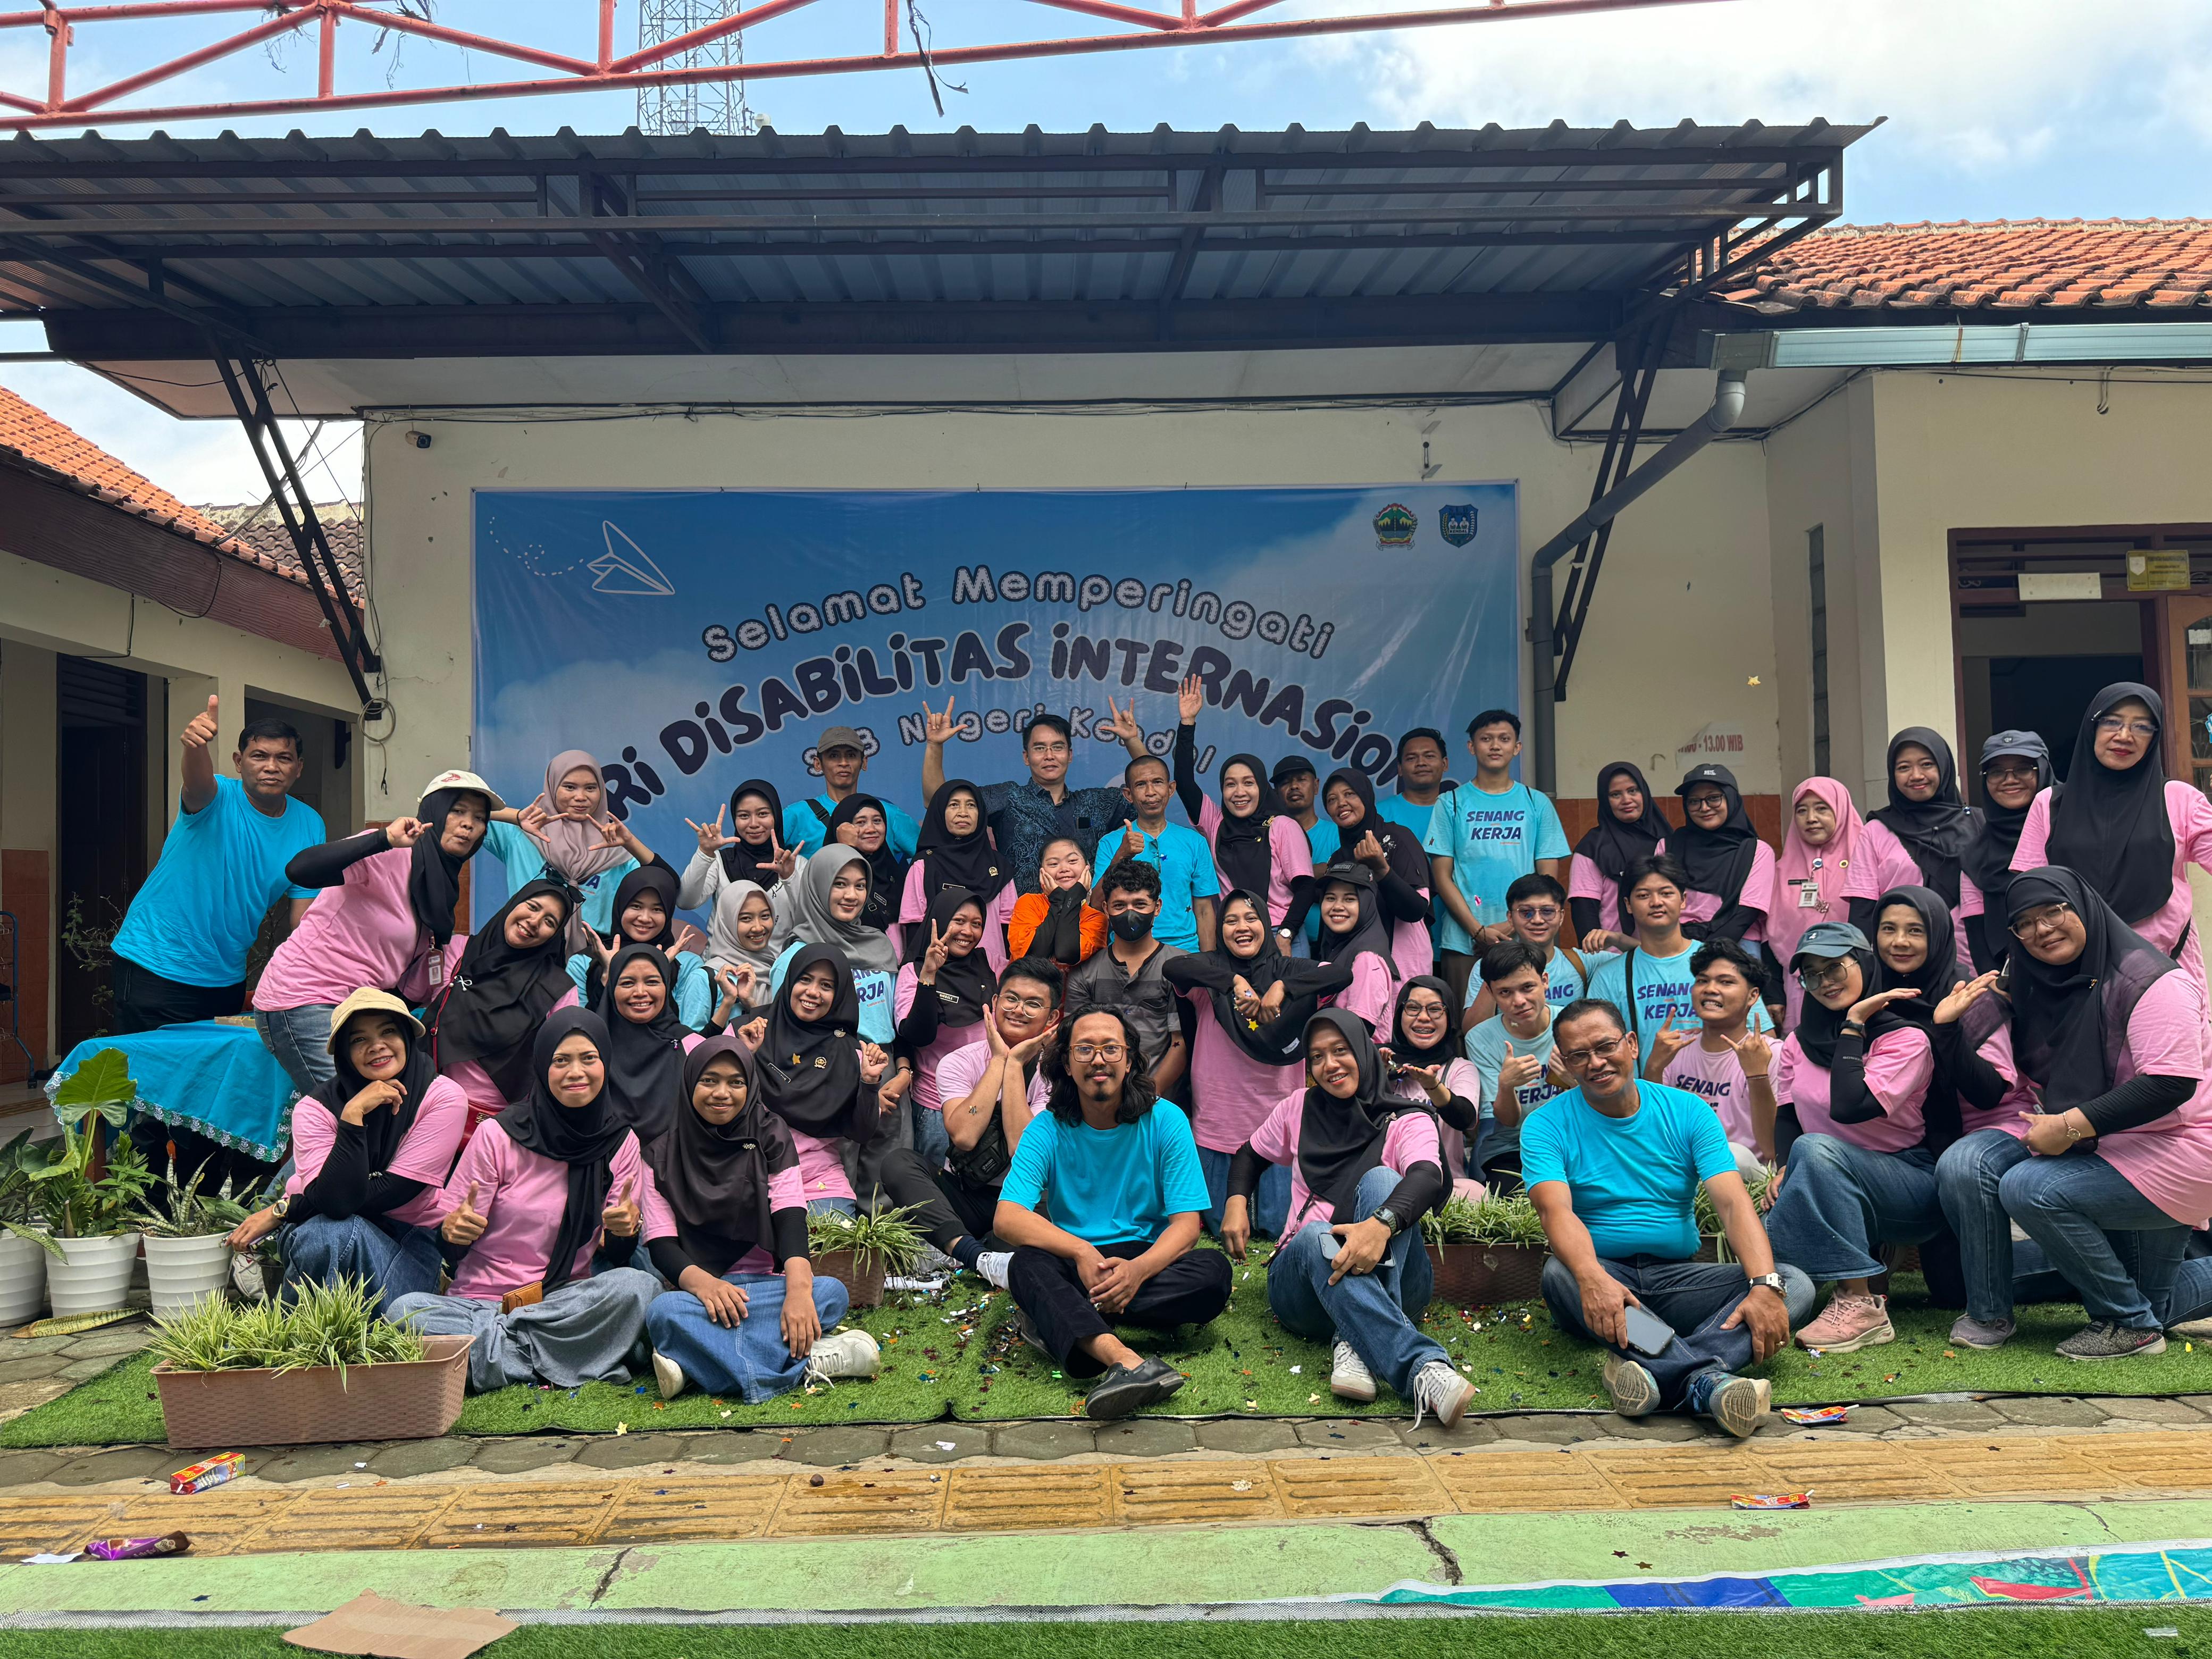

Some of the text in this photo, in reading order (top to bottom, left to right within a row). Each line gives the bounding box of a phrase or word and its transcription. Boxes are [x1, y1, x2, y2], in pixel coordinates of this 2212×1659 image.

[702, 565, 1335, 663] Selamat Memperingati
[802, 726, 881, 777] SB
[1068, 706, 1217, 774] Kedl
[1703, 734, 1725, 752] 13.00
[1726, 734, 1744, 752] WIB
[1466, 810, 1524, 822] SENANG
[1471, 827, 1521, 840] KERJA
[856, 981, 884, 1003] RJA
[1544, 984, 1574, 1000] ANG
[1637, 983, 1692, 1000] SENAN
